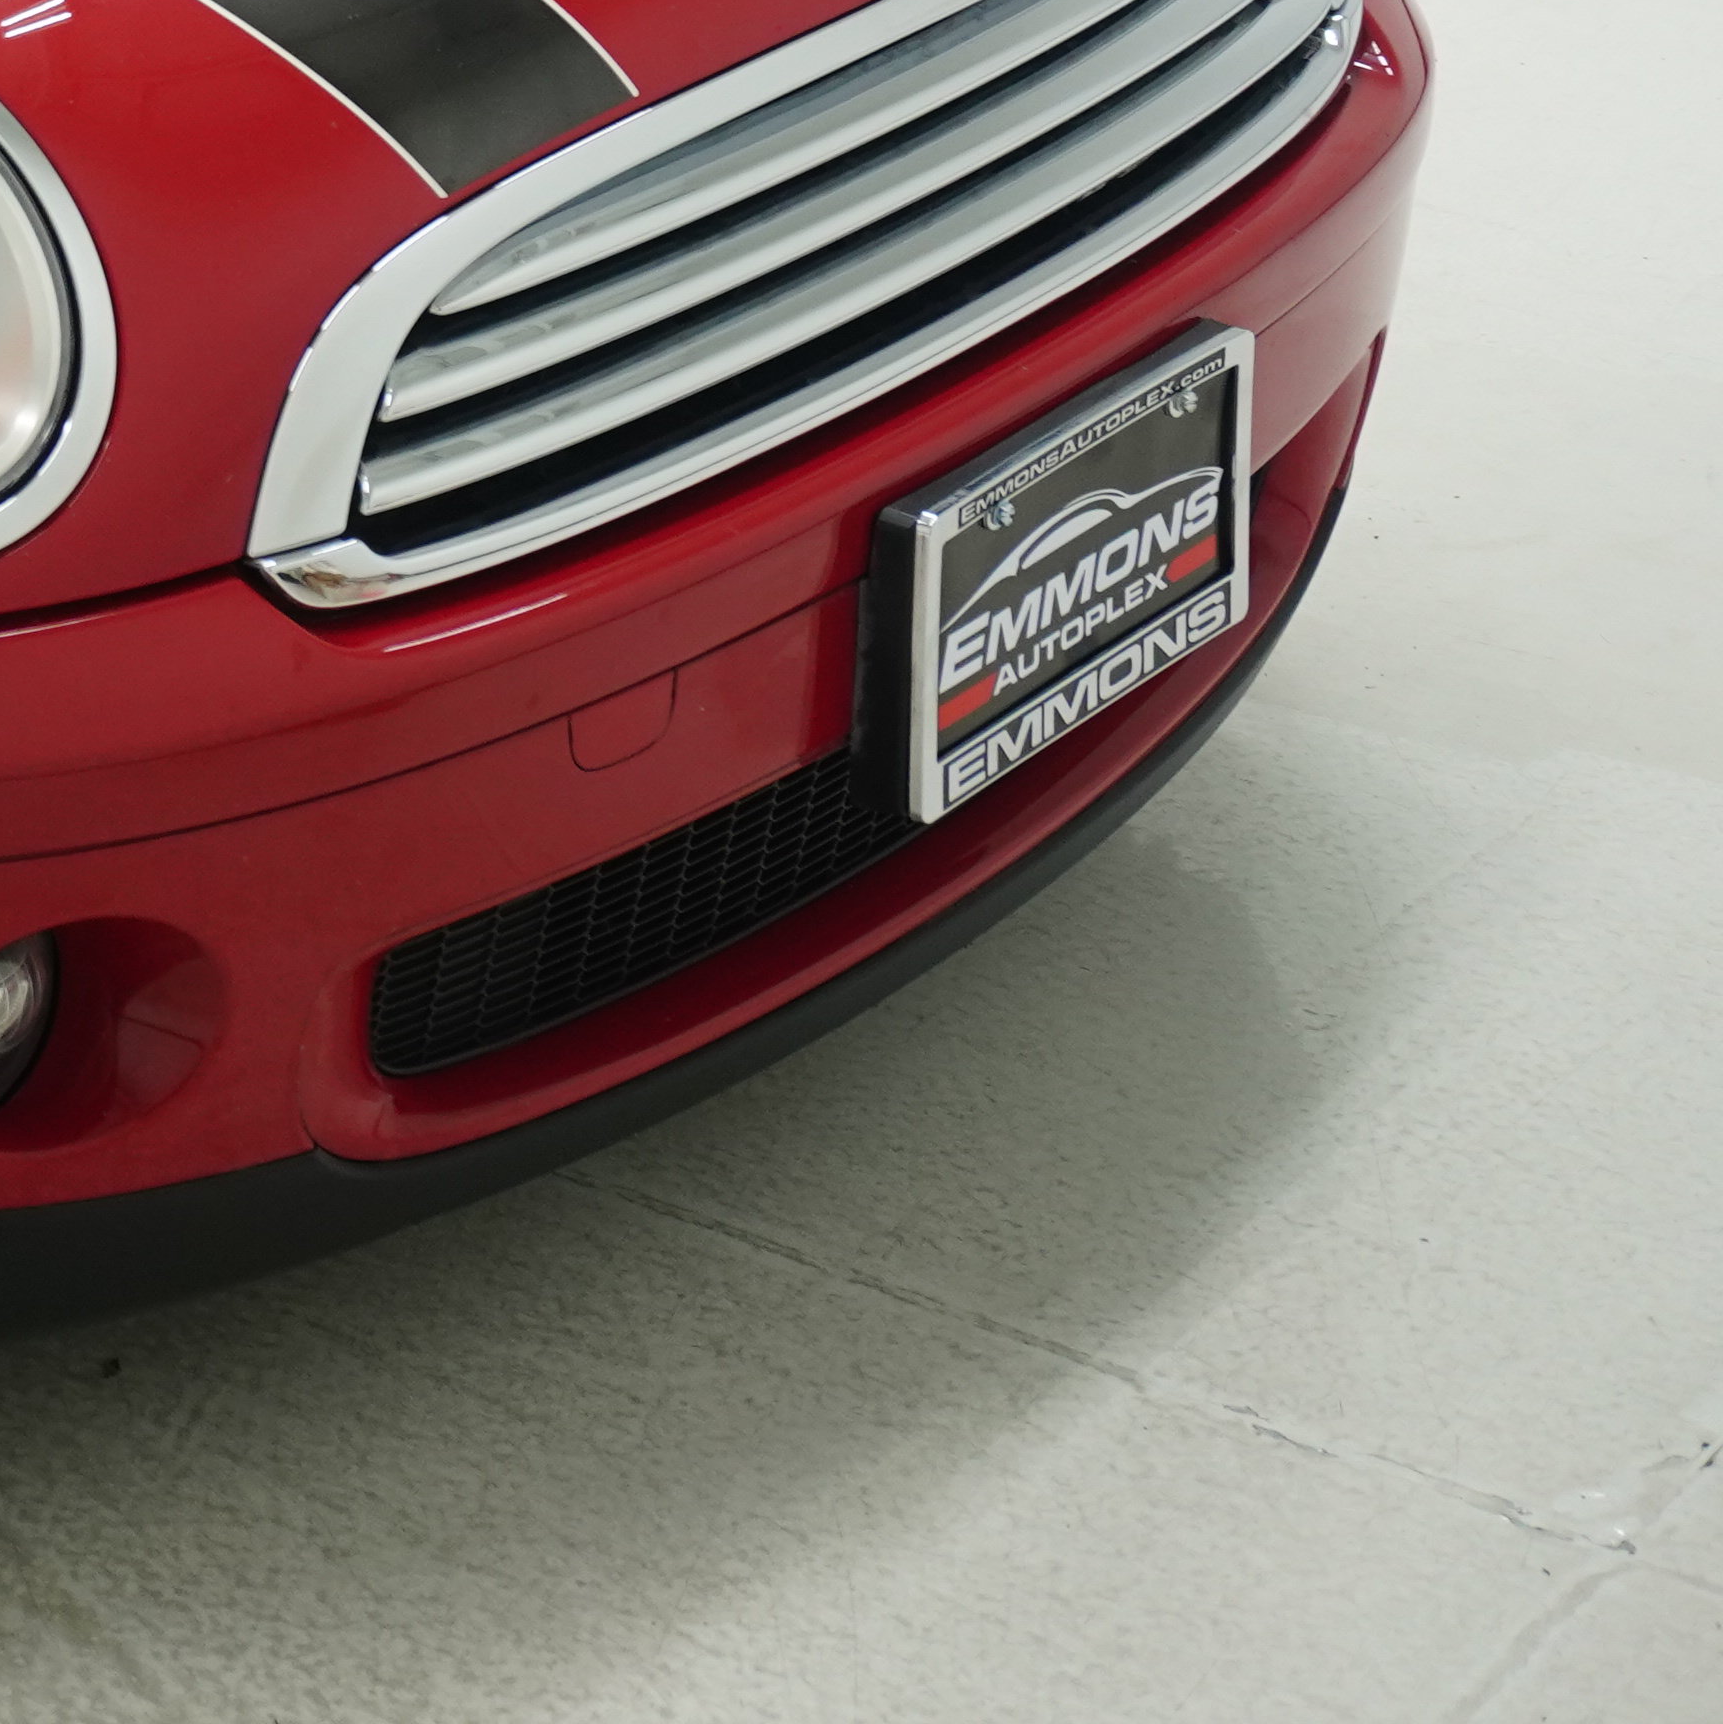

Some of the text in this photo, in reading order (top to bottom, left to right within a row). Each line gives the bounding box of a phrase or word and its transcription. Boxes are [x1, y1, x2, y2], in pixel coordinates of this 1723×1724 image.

[959, 355, 1223, 524] EMMONSAUTOPLEX.com
[939, 482, 1221, 693] EMMONS
[992, 564, 1168, 696] AUTOPLEX
[949, 589, 1226, 802] EMMONS
